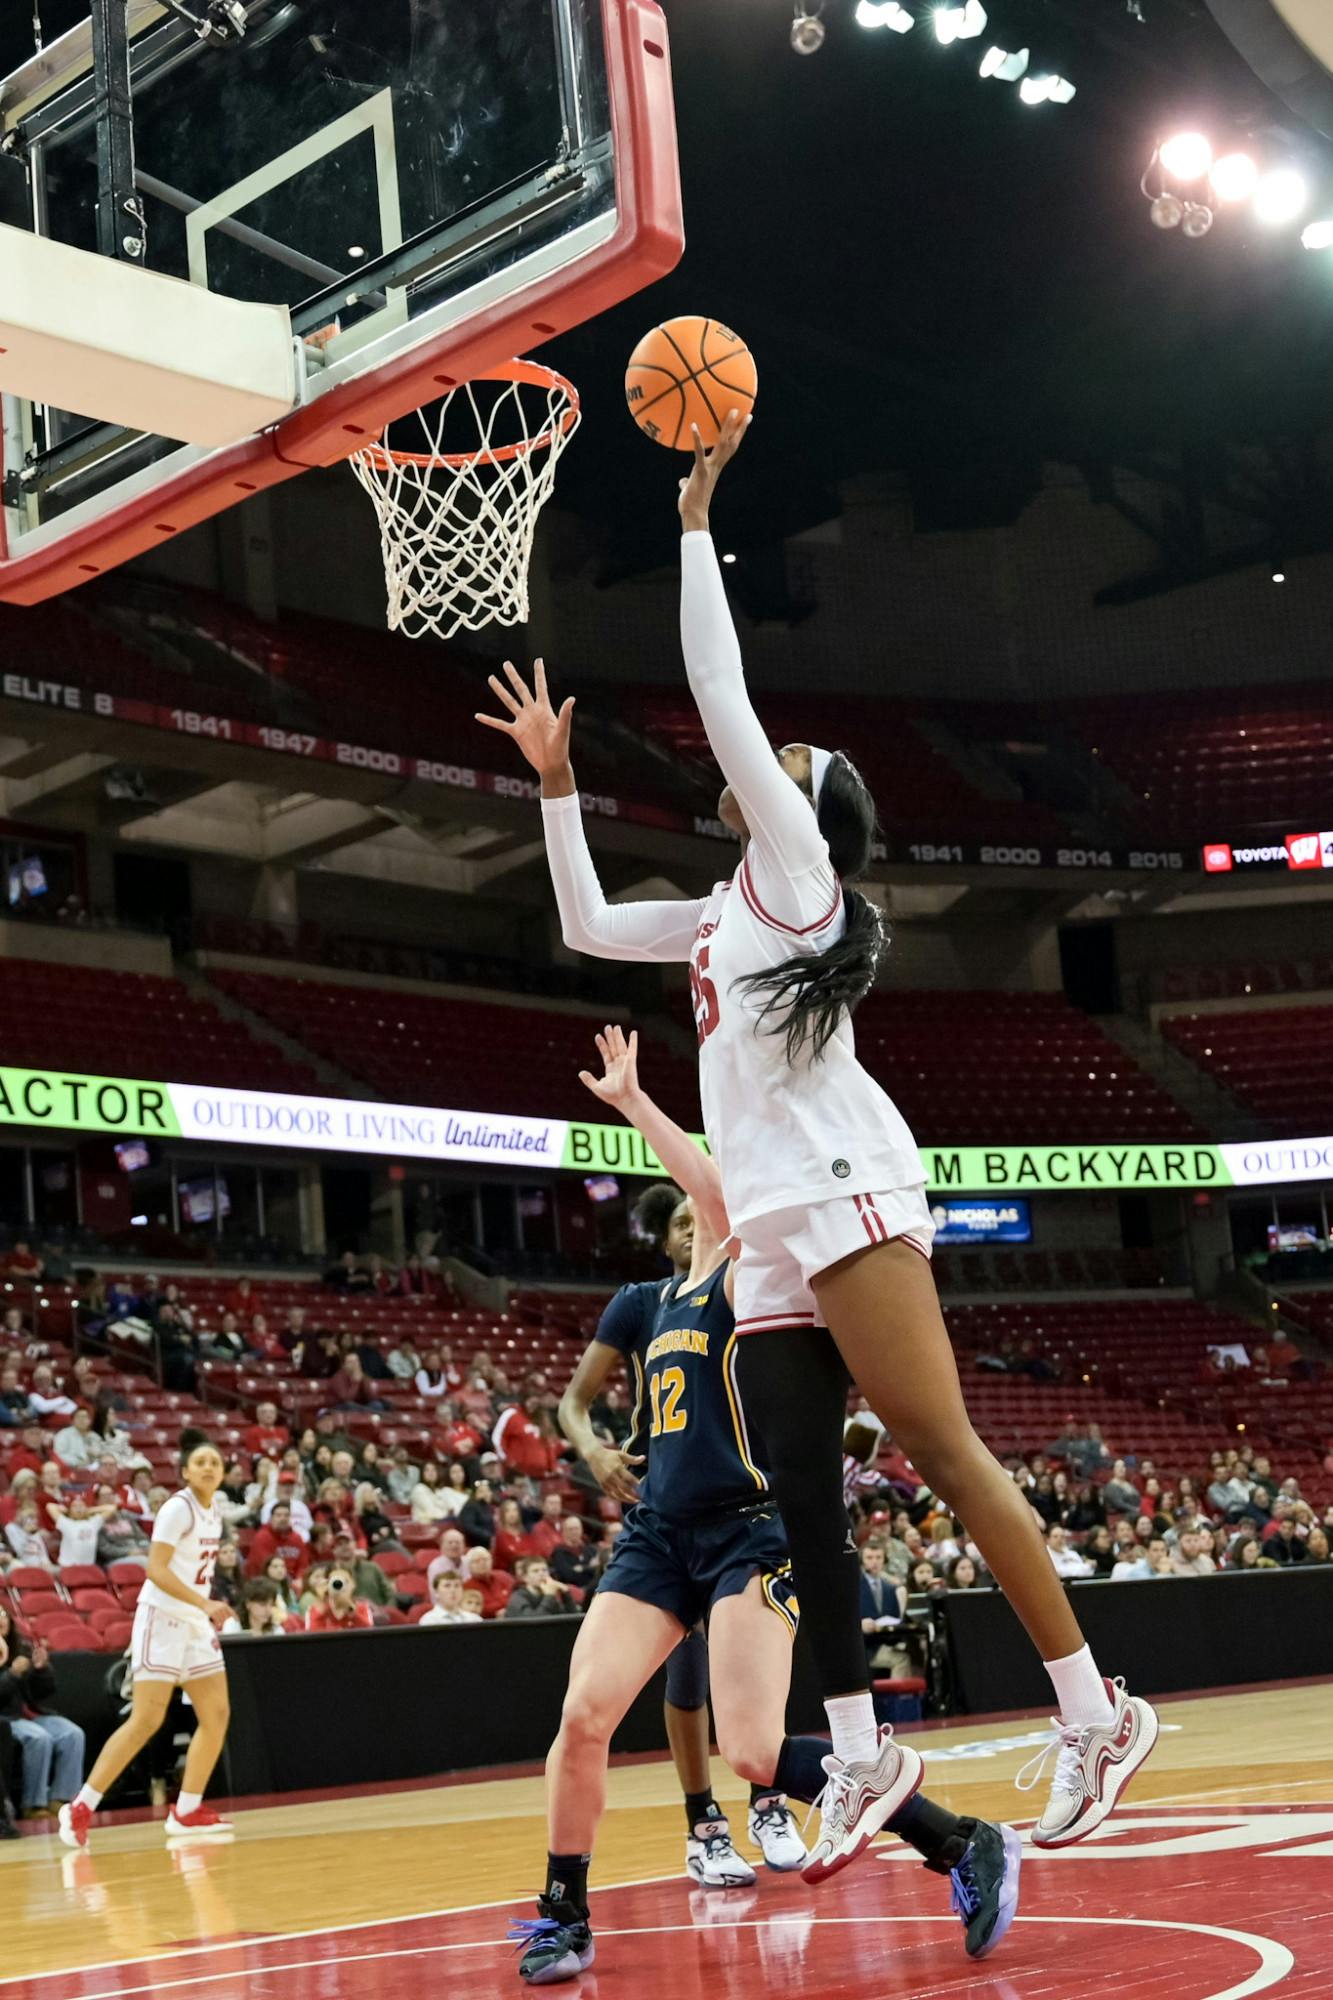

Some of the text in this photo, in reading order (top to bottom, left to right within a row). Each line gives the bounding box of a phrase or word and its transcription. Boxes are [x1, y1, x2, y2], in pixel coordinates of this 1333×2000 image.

[4, 674, 81, 709] ELITE
[171, 710, 232, 739] 1941
[258, 727, 317, 755] 1947
[336, 743, 400, 772] 2000
[416, 760, 477, 788] 2005
[579, 792, 619, 816] 015
[909, 845, 963, 862] 1941
[980, 846, 1041, 865] 2000
[1057, 849, 1113, 867] 2014
[1128, 852, 1183, 868] 2015
[1232, 846, 1289, 863] TOYOTA
[193, 1098, 550, 1153] OUTDOOR LIVING Unlimited
[571, 1129, 660, 1169] BUIL
[984, 1151, 1217, 1184] BACKYARD
[650, 1366, 687, 1438] 12
